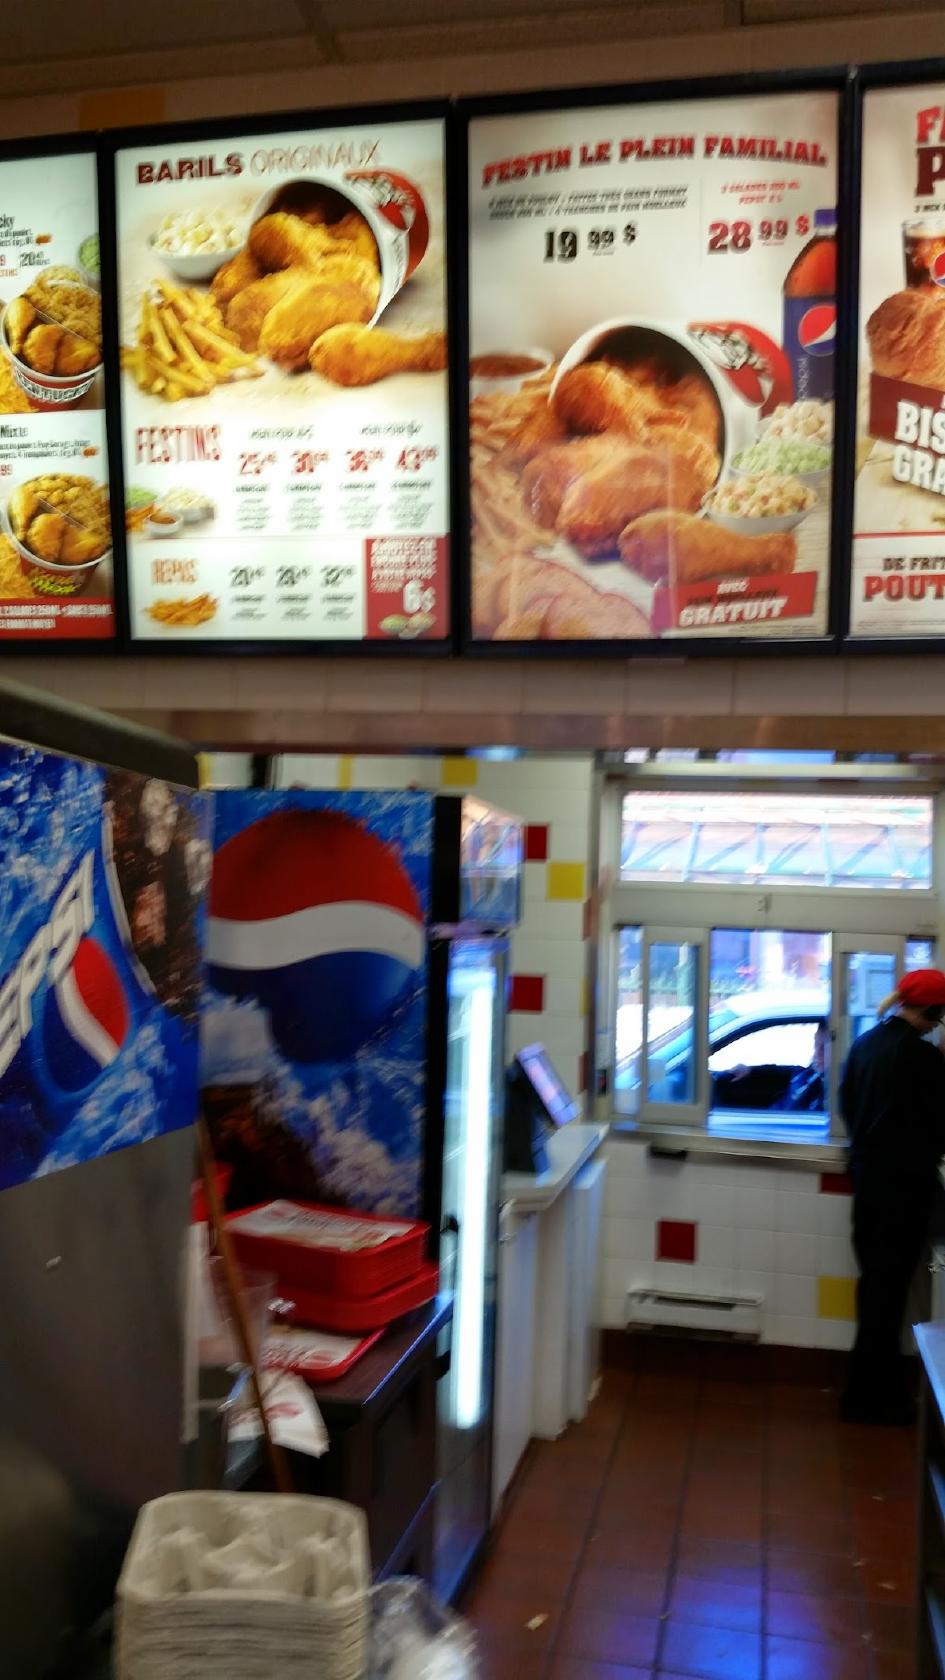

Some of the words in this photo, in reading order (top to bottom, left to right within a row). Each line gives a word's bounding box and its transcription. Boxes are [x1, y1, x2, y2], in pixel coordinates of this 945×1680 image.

[916, 106, 945, 143] F
[137, 152, 243, 184] BARILS
[251, 139, 381, 175] ORIGINAUX
[482, 146, 572, 187] FESTIN
[579, 140, 611, 167] LE
[619, 136, 695, 162] PLEIN
[703, 136, 828, 167] FAMILIAL
[543, 228, 578, 263] 19
[587, 228, 615, 250] 99
[622, 221, 637, 245] $
[708, 220, 752, 254] 28
[759, 220, 789, 240] 99
[795, 215, 810, 235] $
[136, 425, 221, 464] FESTINS
[882, 557, 905, 571] DE
[863, 574, 945, 602] POUT
[679, 597, 788, 627] GRATUIT
